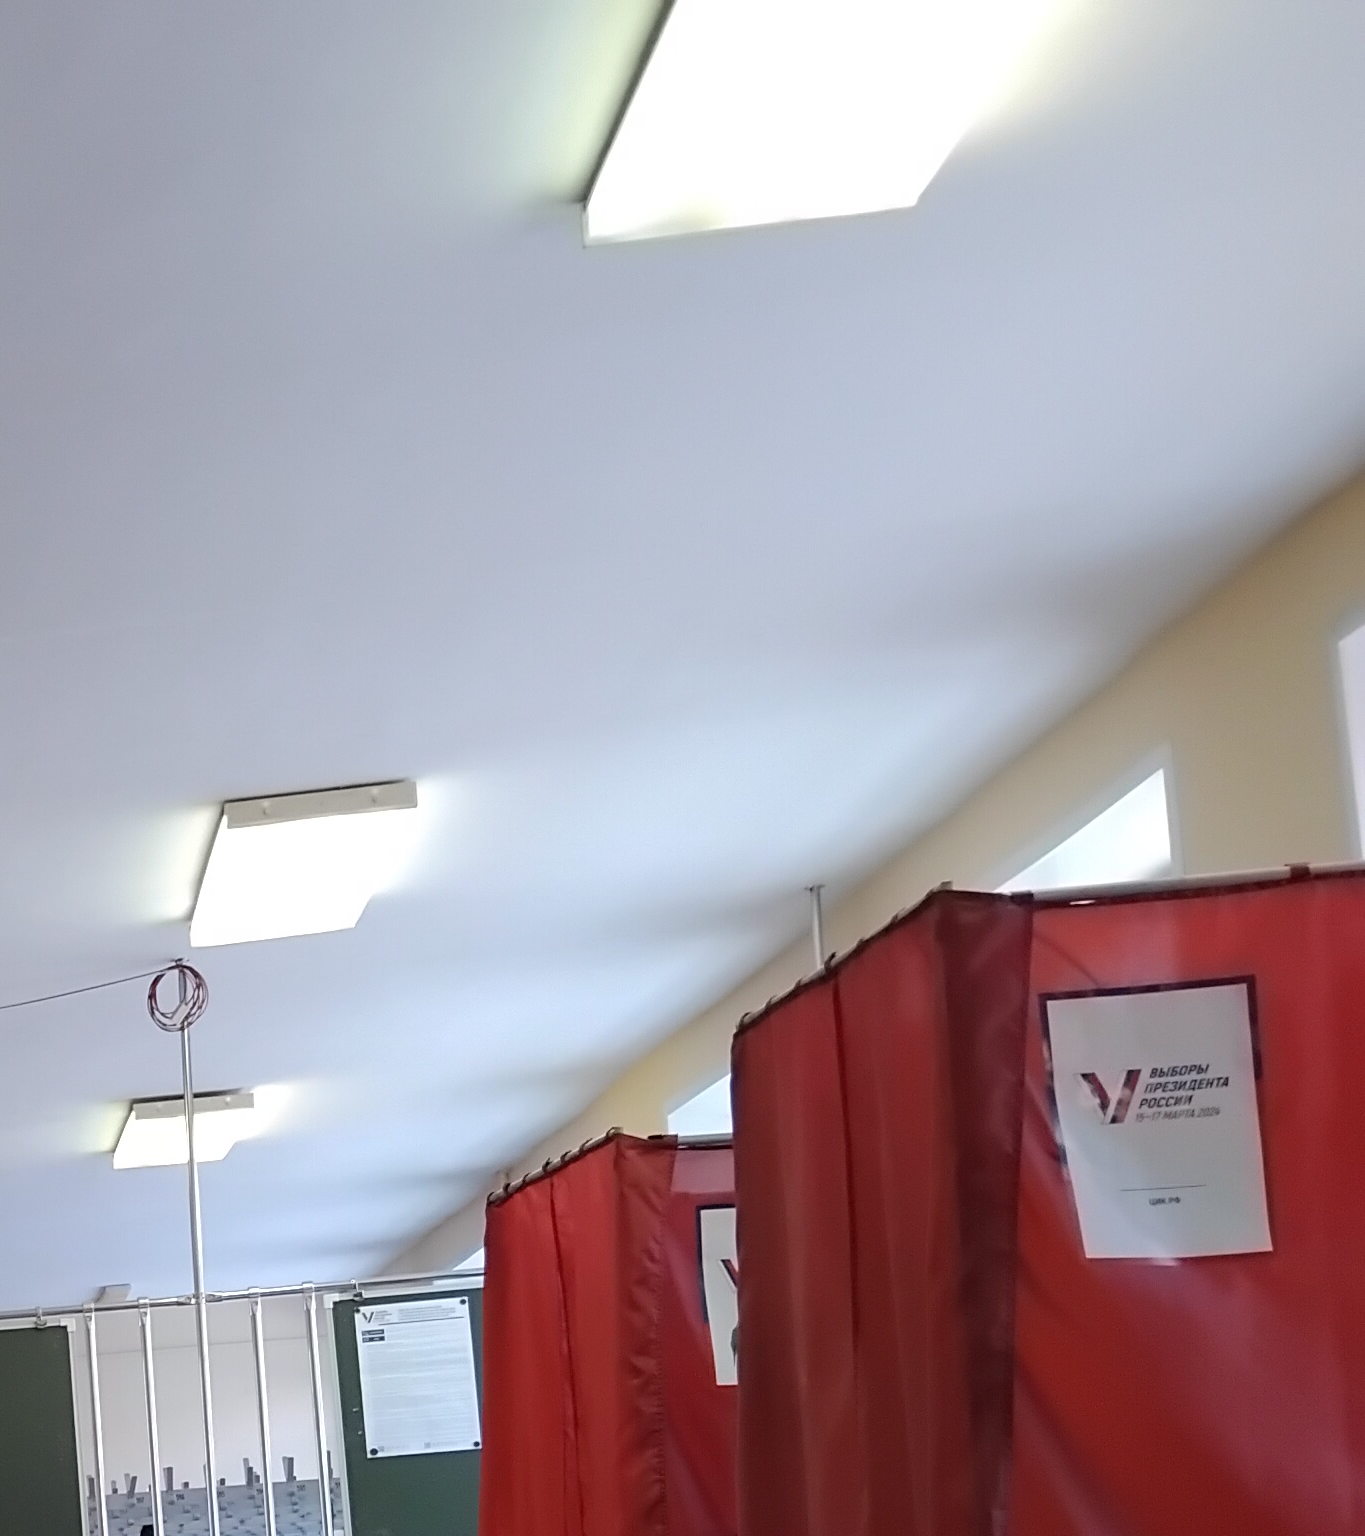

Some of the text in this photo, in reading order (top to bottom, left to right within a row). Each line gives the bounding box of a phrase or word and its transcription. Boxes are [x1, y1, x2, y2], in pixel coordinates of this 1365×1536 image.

[1149, 1064, 1210, 1079] ВЫБОРЫ
[1144, 1076, 1230, 1094] ПРЕЗИДЕНТА
[1138, 1095, 1194, 1109] РОССИИ
[1162, 1109, 1195, 1120] МАРТА
[1196, 1107, 1221, 1118] 2024
